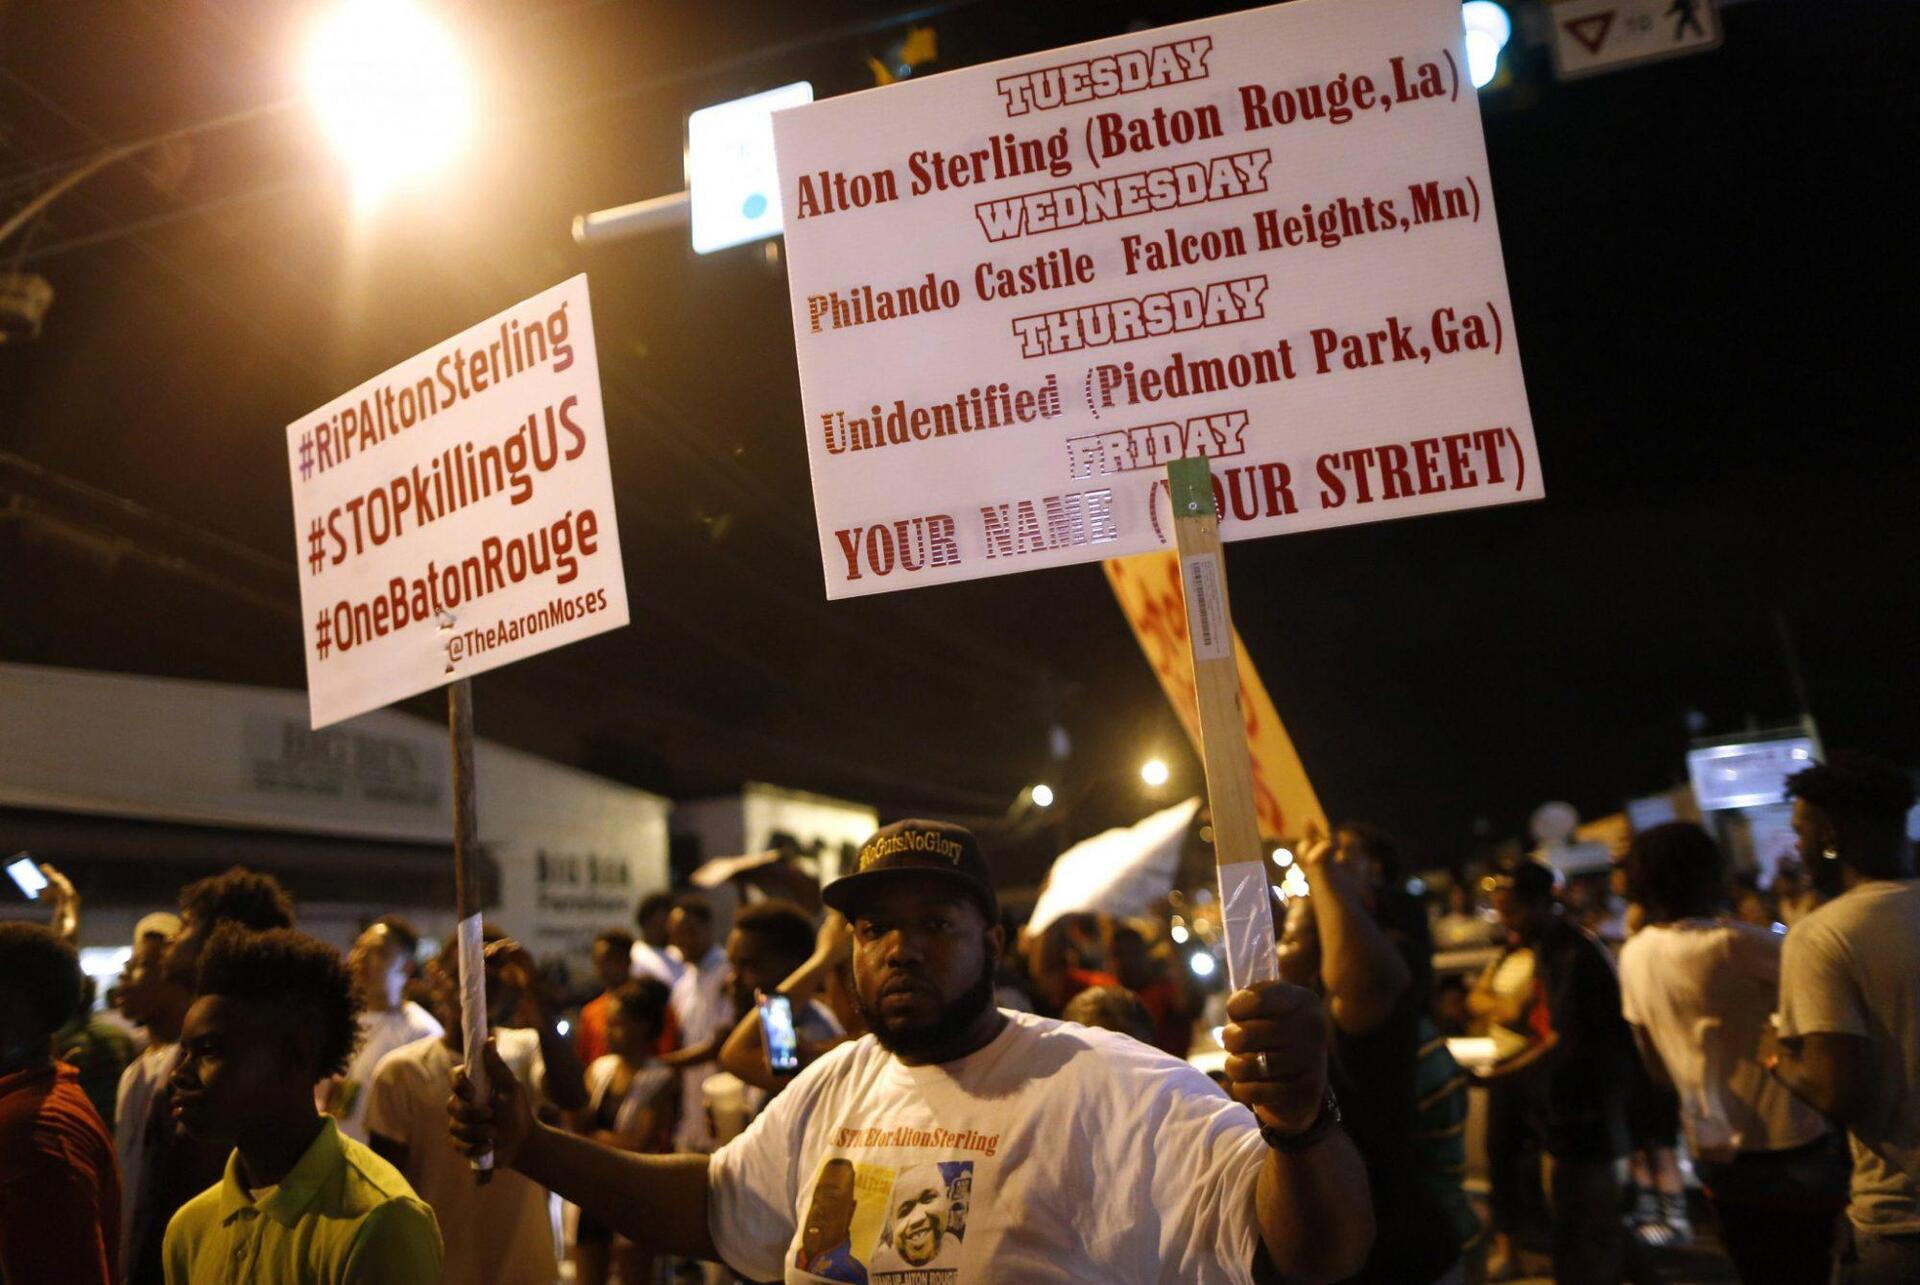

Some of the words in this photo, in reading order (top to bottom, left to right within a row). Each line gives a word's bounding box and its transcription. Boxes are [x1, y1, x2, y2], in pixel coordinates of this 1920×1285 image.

[996, 36, 1213, 117] TUESDAY
[797, 168, 899, 220] Alton
[908, 127, 1073, 197] Sterling
[1086, 104, 1225, 168] (Baton
[975, 148, 1273, 243] WEDNESDAY
[807, 272, 960, 334] Philando
[975, 248, 1096, 301] Castile
[1121, 225, 1248, 275] Falcon
[1011, 274, 1269, 360] THURSDAY
[299, 301, 575, 482] #RiPAltonSterling
[820, 374, 1063, 455] Unidentified
[1085, 338, 1297, 420] (Piedmont
[1066, 410, 1249, 480] FRIDAY
[308, 395, 587, 576] #STOPkillingUS
[834, 513, 962, 581] YOUR
[979, 488, 1118, 559] NAME
[1149, 462, 1299, 544] (UR
[1315, 426, 1525, 510] STREET)
[316, 507, 599, 661] #OneBatonRouge
[447, 587, 608, 662] @TheAaronMoses
